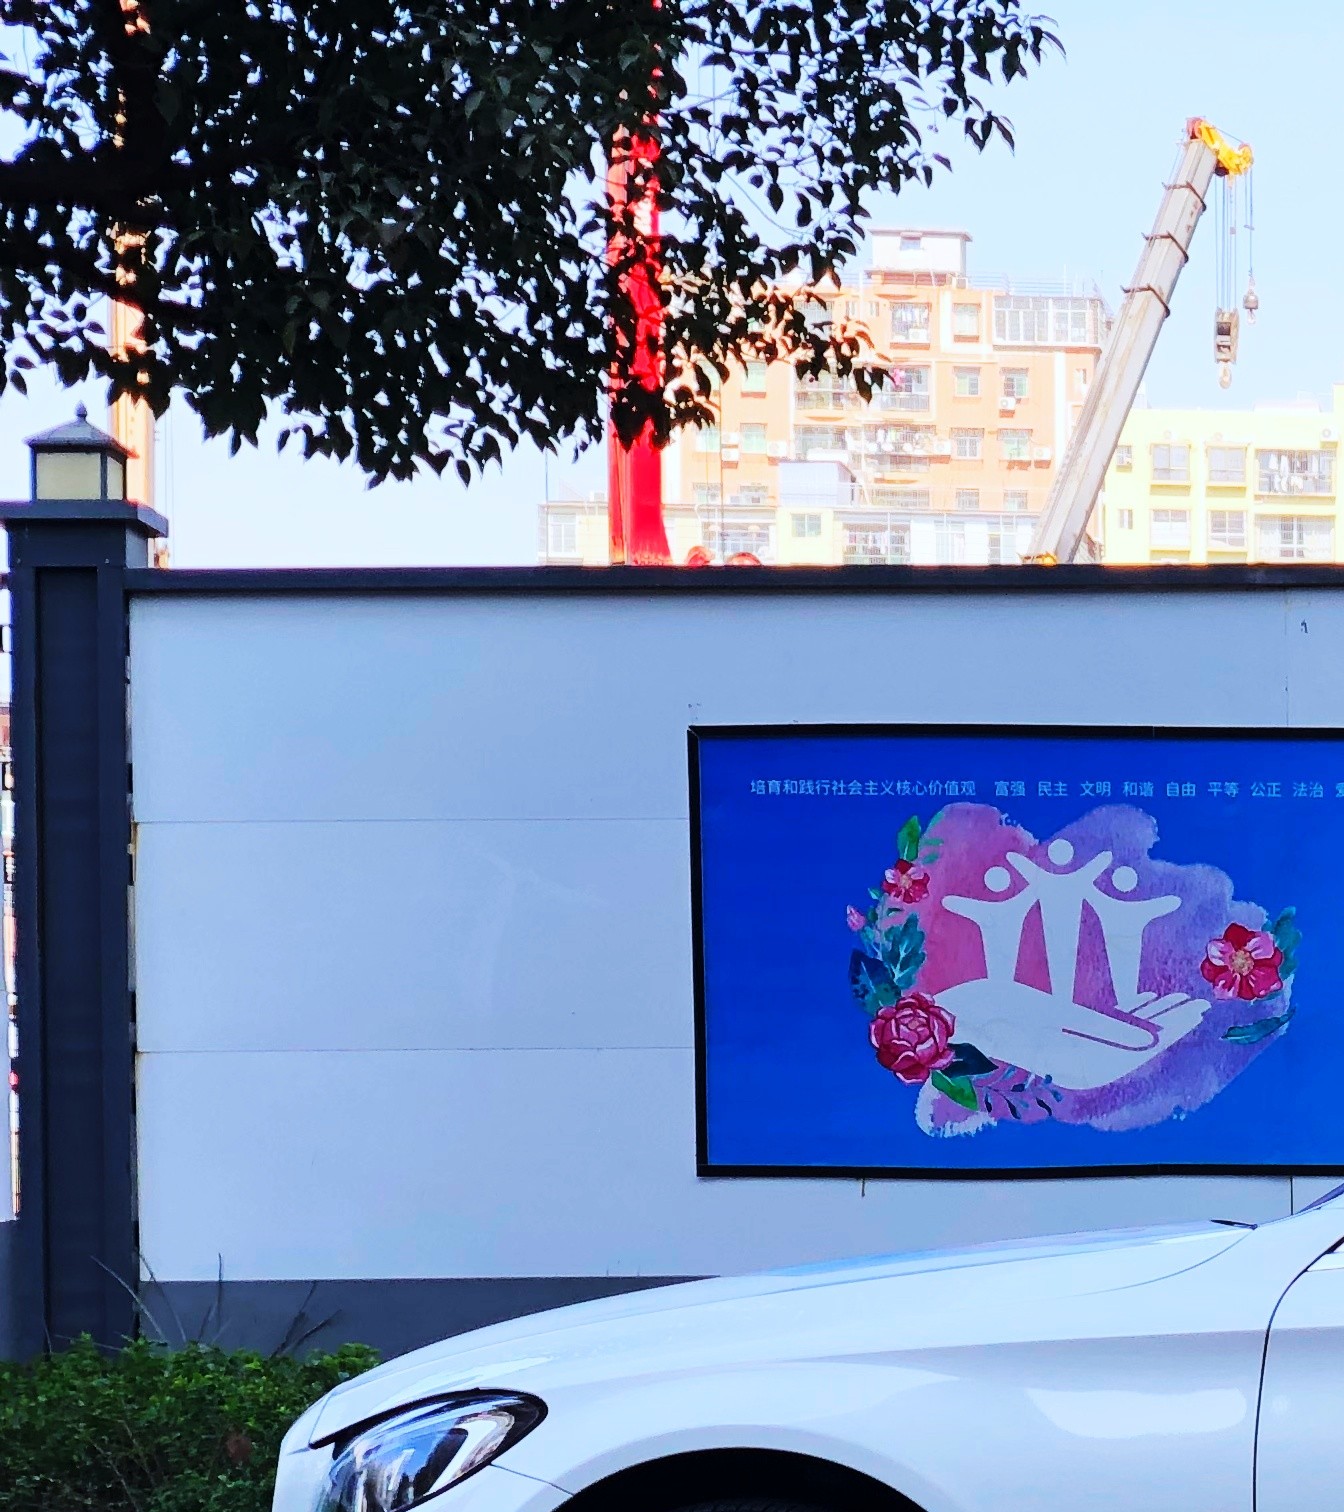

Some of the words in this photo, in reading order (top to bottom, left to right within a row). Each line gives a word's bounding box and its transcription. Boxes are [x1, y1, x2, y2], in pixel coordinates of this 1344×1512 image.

[750, 779, 976, 796] 培育和践行社会主义核心价值观
[995, 781, 1025, 796] 富强
[1039, 781, 1067, 796] 民主
[1080, 781, 1111, 796] 文明
[1123, 782, 1153, 796] 和谐
[1167, 782, 1196, 796] 自由
[1208, 782, 1238, 797] 平等
[1251, 783, 1281, 797] 公正
[1294, 783, 1323, 797] 法治
